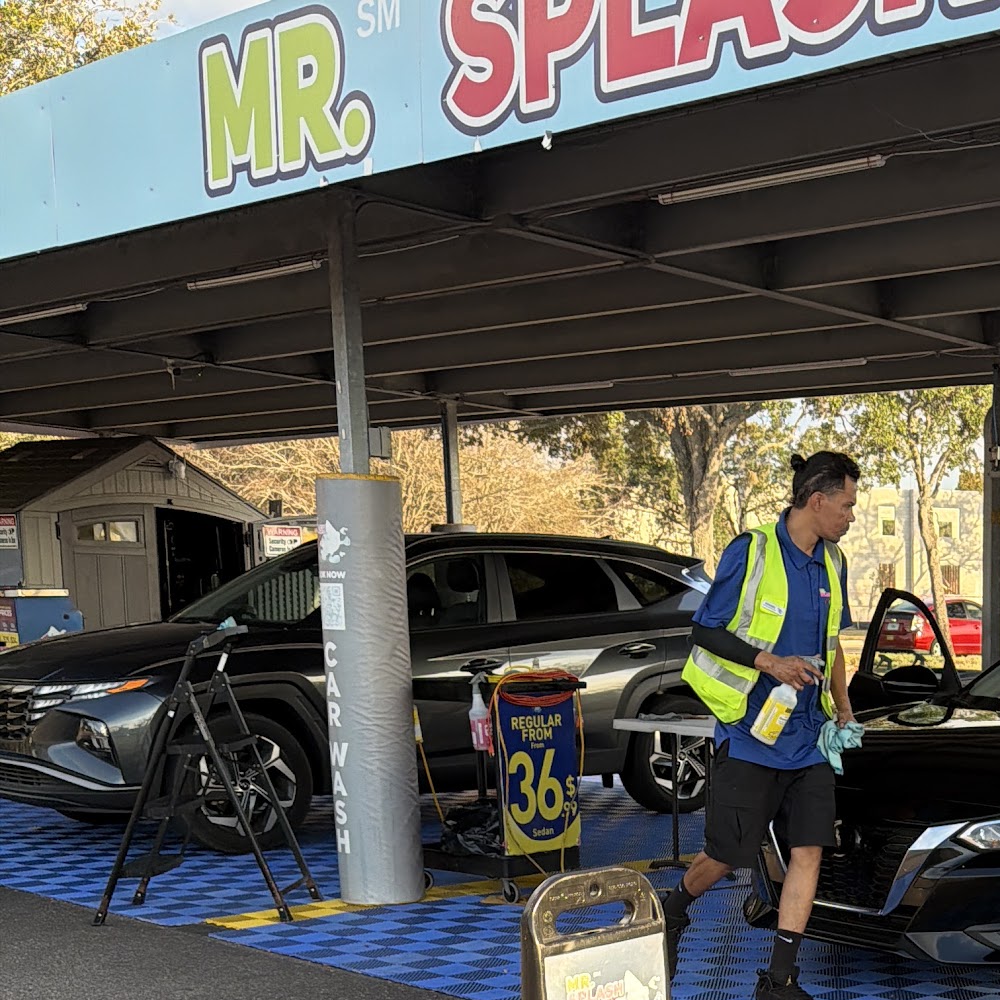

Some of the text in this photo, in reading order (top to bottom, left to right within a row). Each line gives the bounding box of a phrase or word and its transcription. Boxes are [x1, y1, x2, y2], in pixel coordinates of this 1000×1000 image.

[357, 0, 400, 37] SM
[200, 5, 375, 197] MR.
[267, 528, 299, 536] WARNING
[326, 571, 346, 579] NOW
[324, 641, 342, 728] CAR
[511, 713, 562, 731] REGULAR
[521, 727, 553, 742] FROM
[531, 742, 545, 750] From
[508, 748, 564, 825] 36
[329, 742, 351, 854] WASH
[532, 827, 555, 837] Sedan
